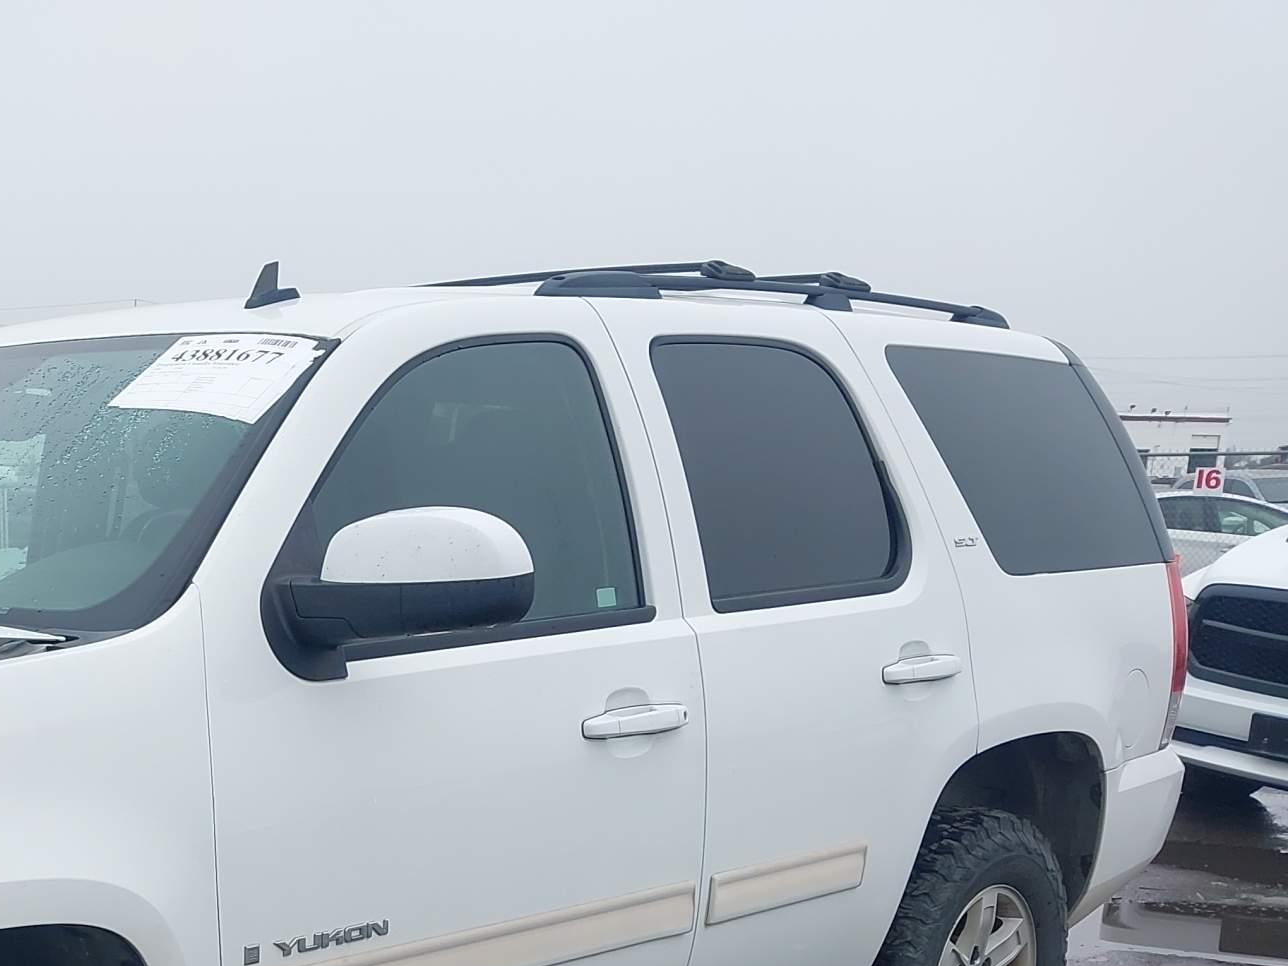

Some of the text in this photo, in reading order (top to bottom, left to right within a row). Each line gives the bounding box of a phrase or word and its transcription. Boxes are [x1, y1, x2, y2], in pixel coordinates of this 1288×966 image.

[171, 348, 284, 364] 43881677
[1196, 469, 1222, 489] 16
[272, 918, 390, 958] YUKON
